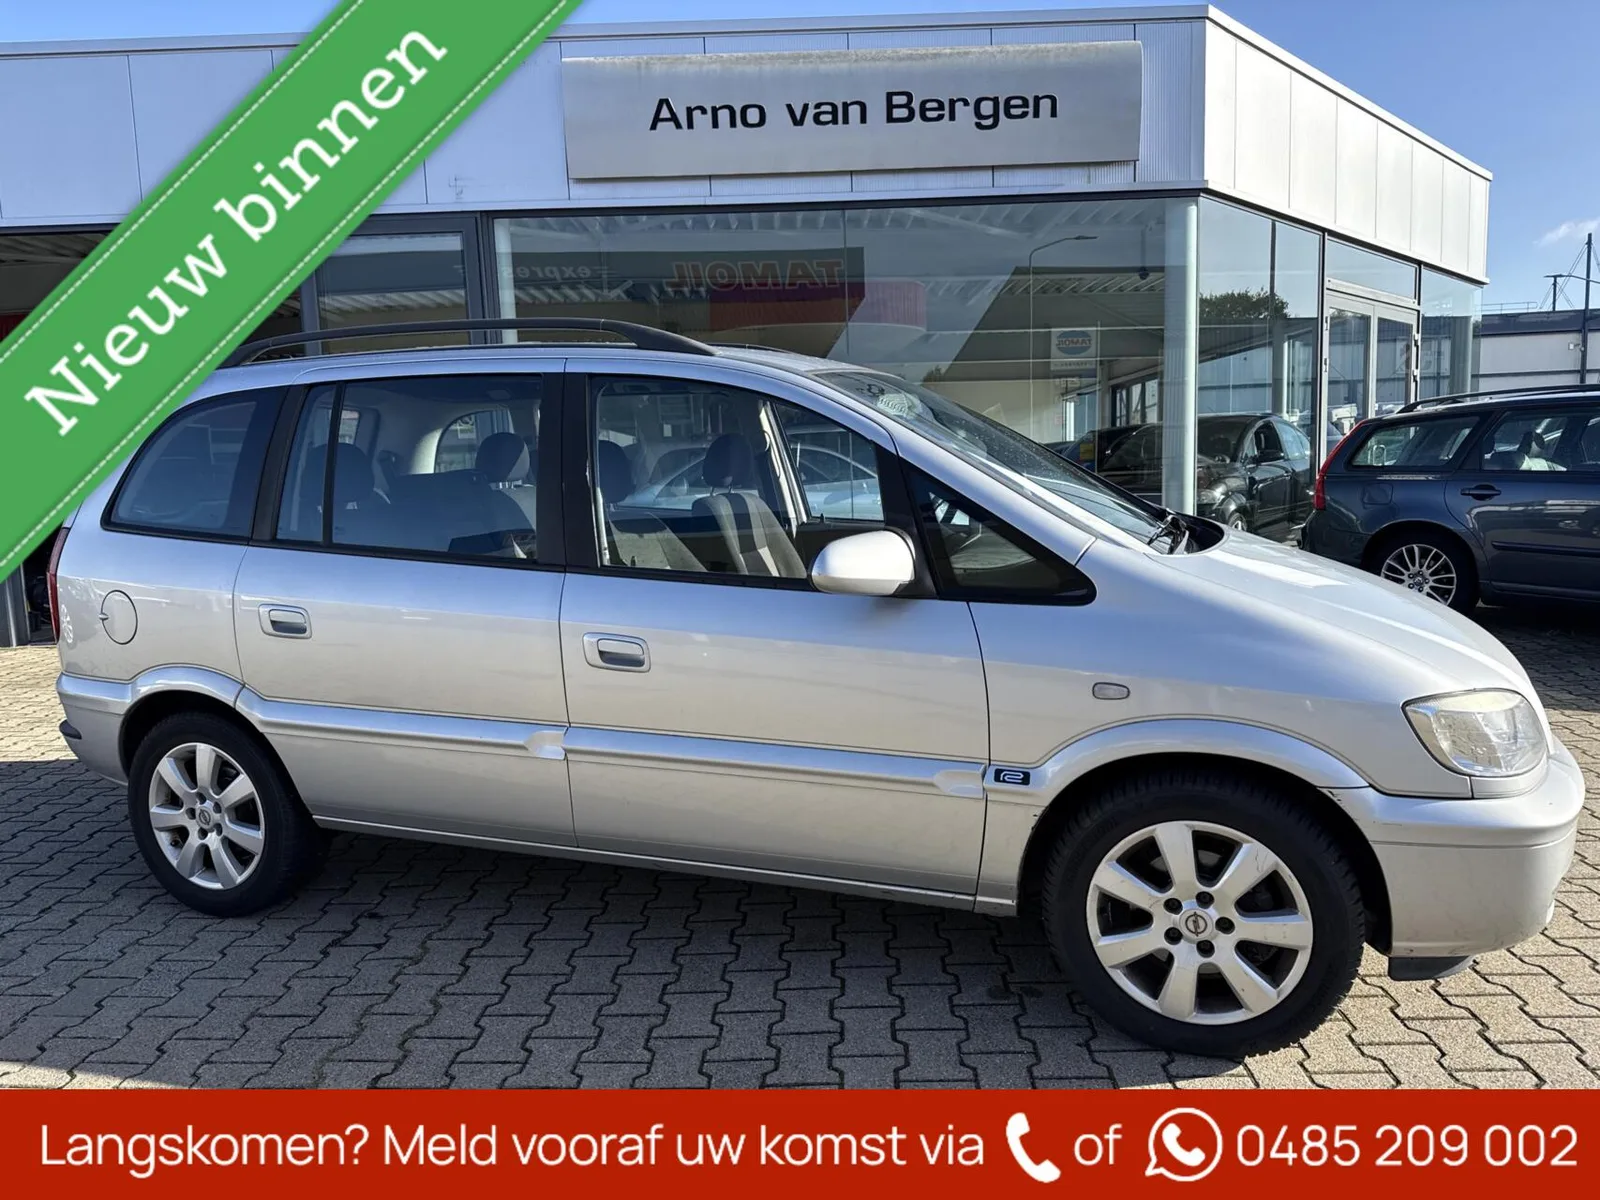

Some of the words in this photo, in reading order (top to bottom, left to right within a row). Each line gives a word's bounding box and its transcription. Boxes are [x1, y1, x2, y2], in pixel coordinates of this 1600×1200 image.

[650, 98, 766, 132] Arno
[786, 101, 867, 127] van
[886, 91, 1058, 131] Bergen
